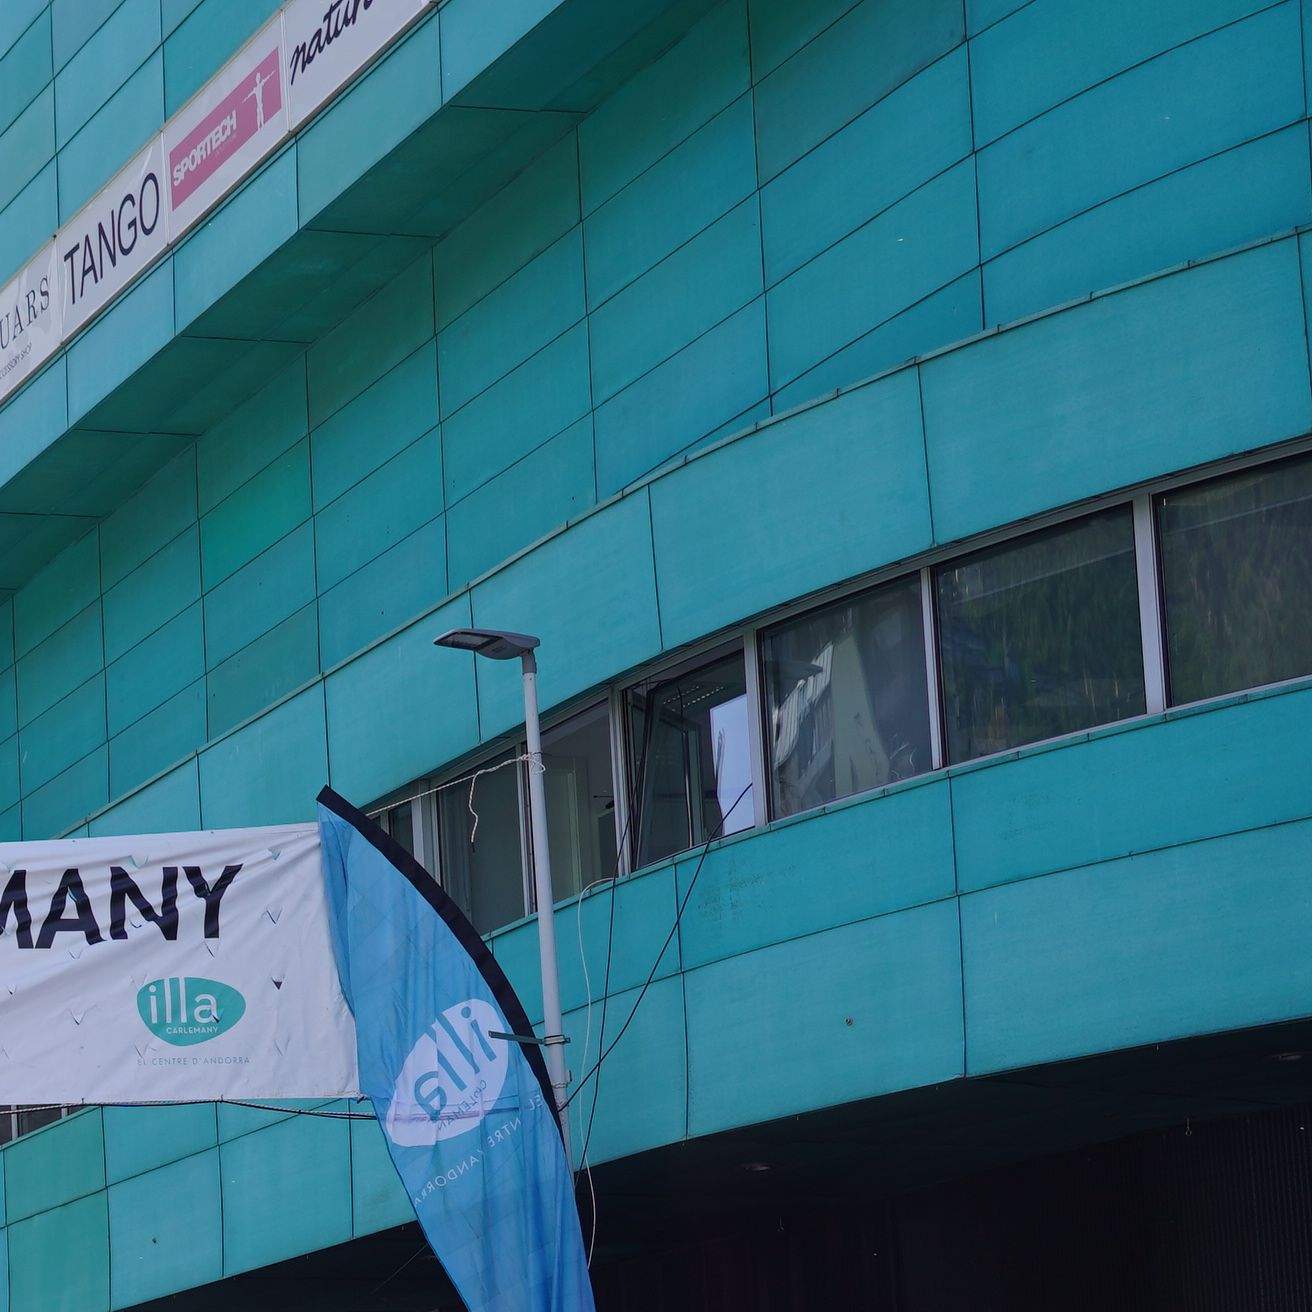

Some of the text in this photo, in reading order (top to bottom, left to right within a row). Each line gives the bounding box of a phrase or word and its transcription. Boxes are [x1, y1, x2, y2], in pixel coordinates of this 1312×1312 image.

[173, 110, 237, 186] SPORTECH
[64, 172, 160, 304] TANGO
[148, 976, 222, 1024] illa
[165, 1025, 219, 1035] CARLEMANY
[136, 1056, 250, 1067] EL CENTRE D'ANDORRA
